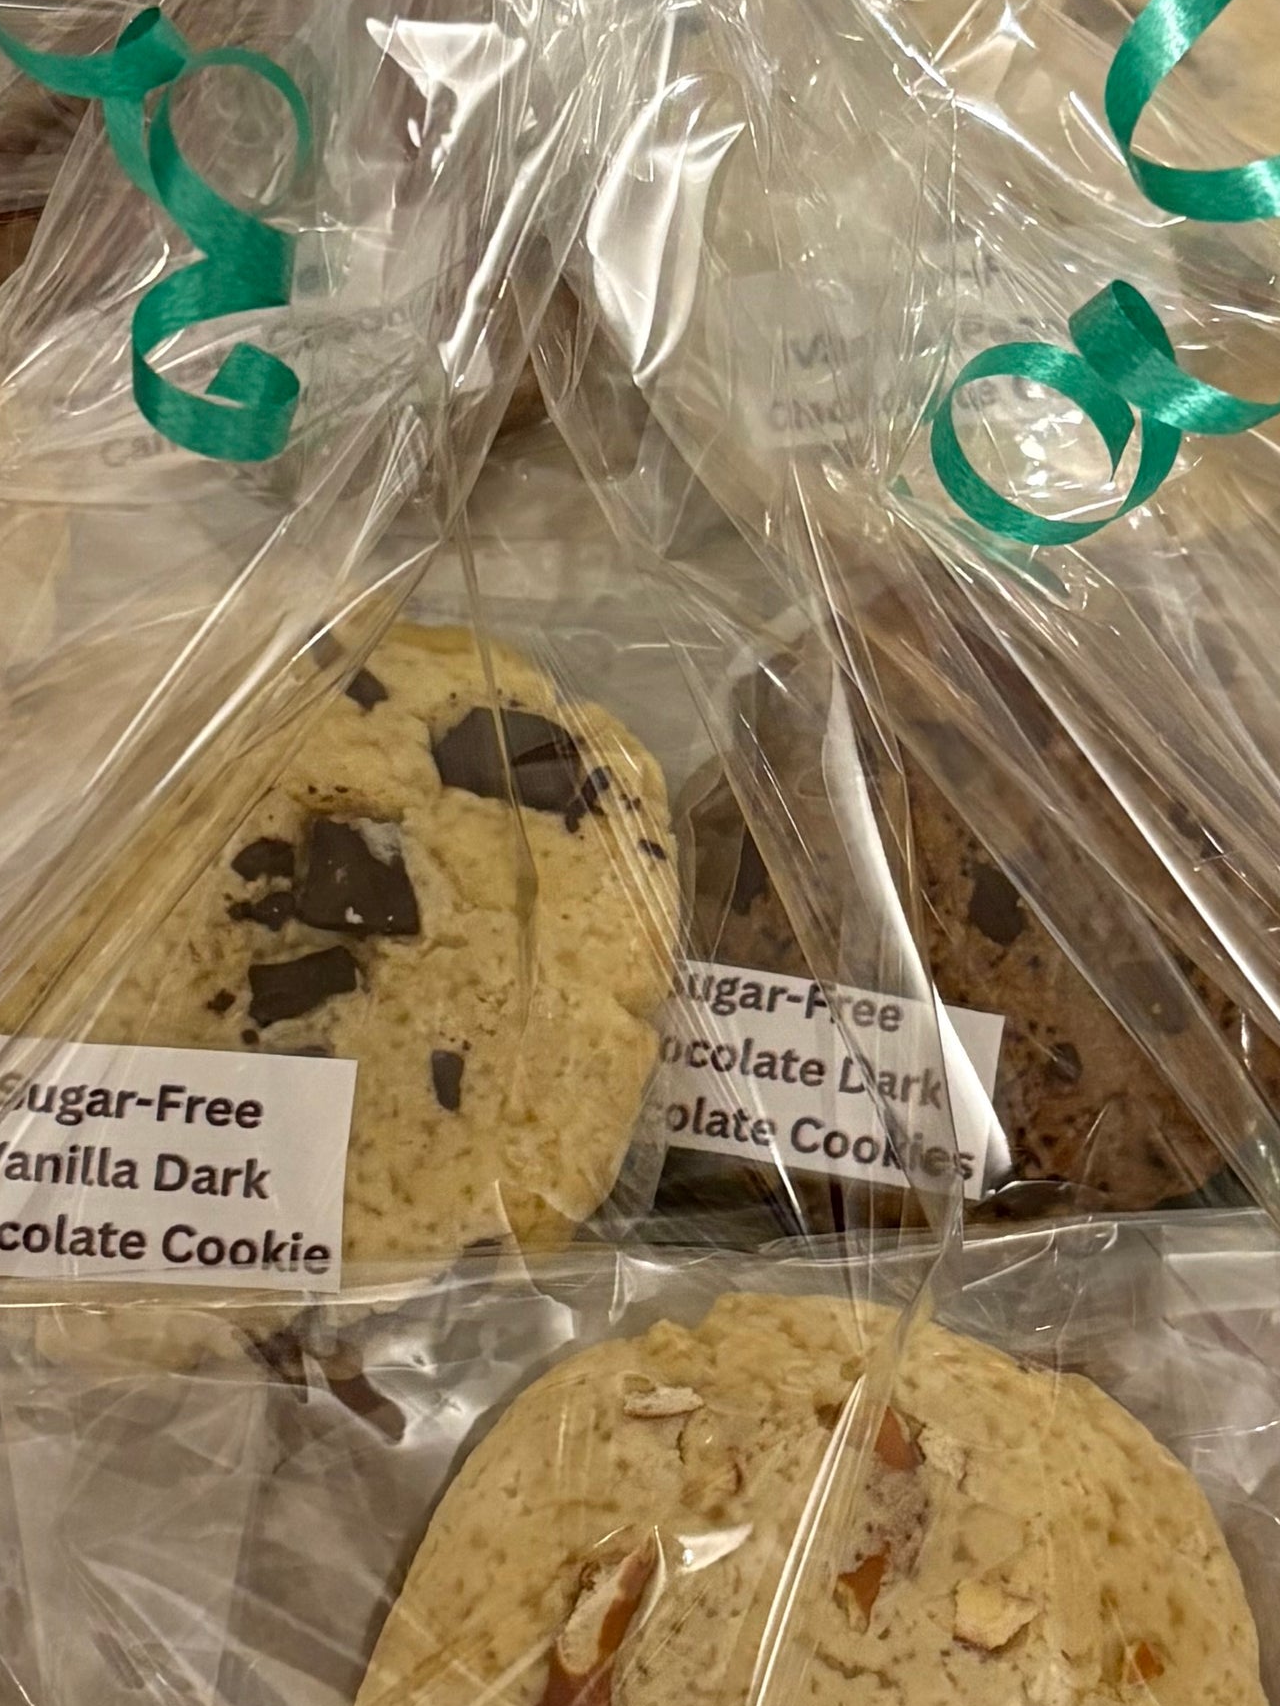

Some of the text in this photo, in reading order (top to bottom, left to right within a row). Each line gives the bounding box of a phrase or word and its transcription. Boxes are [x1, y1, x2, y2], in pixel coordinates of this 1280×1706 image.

[685, 971, 905, 1033] ugar-Free
[153, 1153, 273, 1200] Dark
[161, 1224, 332, 1275] Cookie
